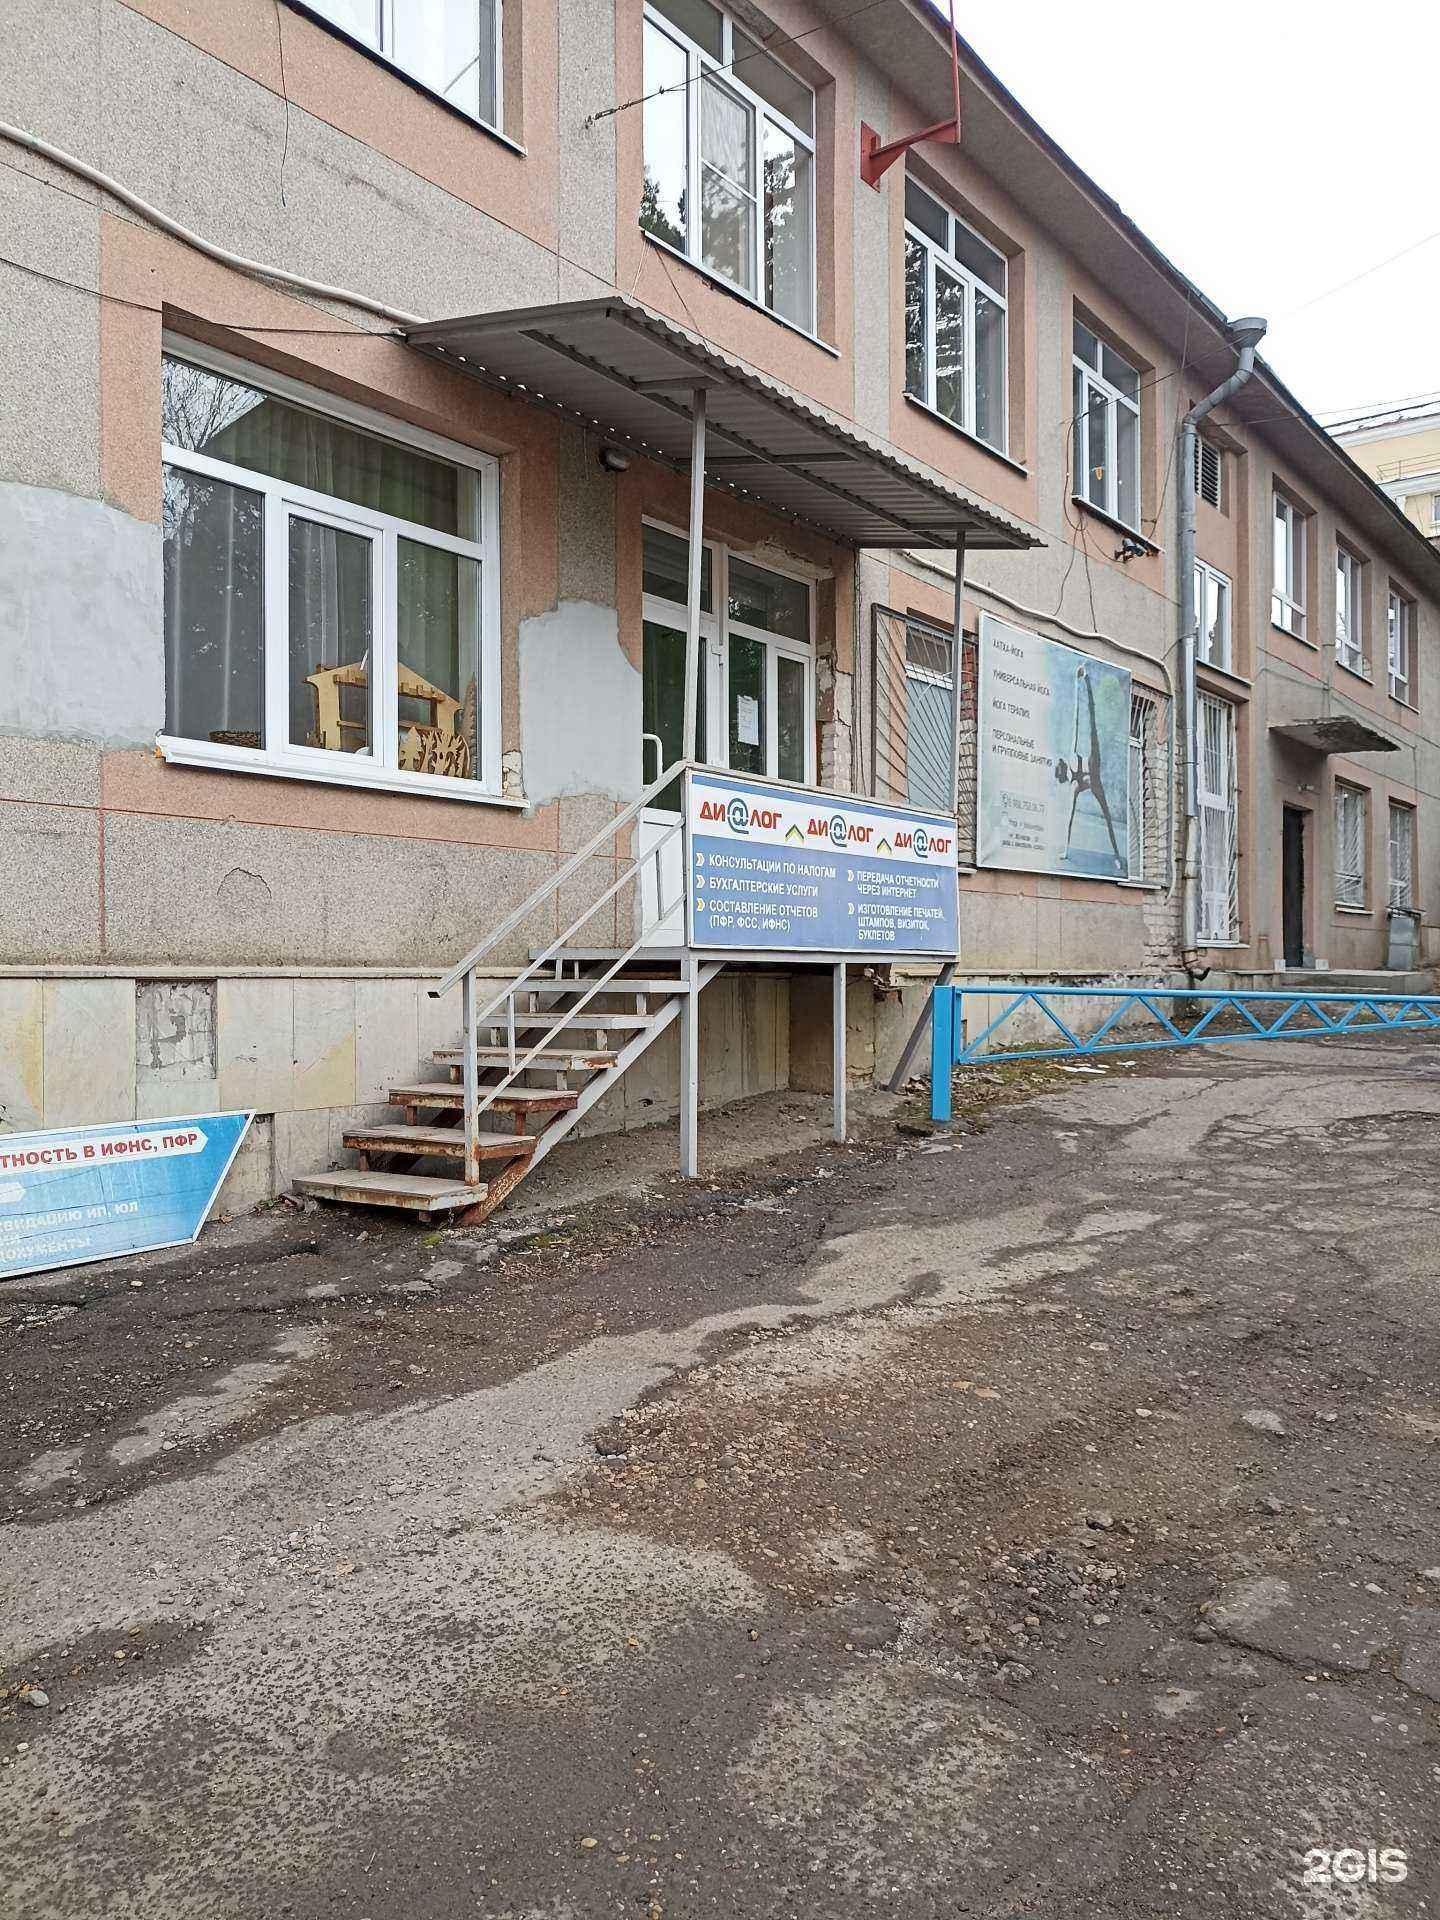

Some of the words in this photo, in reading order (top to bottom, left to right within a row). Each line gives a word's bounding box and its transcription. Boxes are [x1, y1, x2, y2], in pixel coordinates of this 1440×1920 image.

[709, 853, 781, 873] КОНСУЛЬТАЦИИ
[783, 862, 796, 873] ПО
[797, 864, 836, 878] НАЛОГАМ
[709, 876, 785, 895] БУХГАЛТЕРСКИЕ
[786, 884, 818, 897] УСЛУГИ
[857, 870, 895, 884] ПЕРЕДАЧА
[895, 874, 939, 888] ОТЧЕТНОСТИ
[857, 883, 880, 895] ЧЕРЕЗ
[881, 886, 917, 898] ИНТЕРНЕТ
[709, 899, 777, 915] СОСТАВЛЕНИЕ
[779, 905, 818, 918] ОТЧЕТОВ
[857, 903, 913, 917] ИЗГОТОВЛЕНИЕ
[762, 918, 791, 932] ИФНС)
[858, 916, 896, 929] ШТАМПОВ,
[897, 919, 930, 931] ВИЗИТОК,
[858, 929, 895, 941] БУКЛЕТОВ
[0, 1148, 77, 1168] ТНОСТЬ
[83, 1144, 95, 1159] В
[101, 1138, 157, 1156] ИФНС,
[162, 1133, 197, 1148] ПФР
[115, 1201, 138, 1214] ЮЛ
